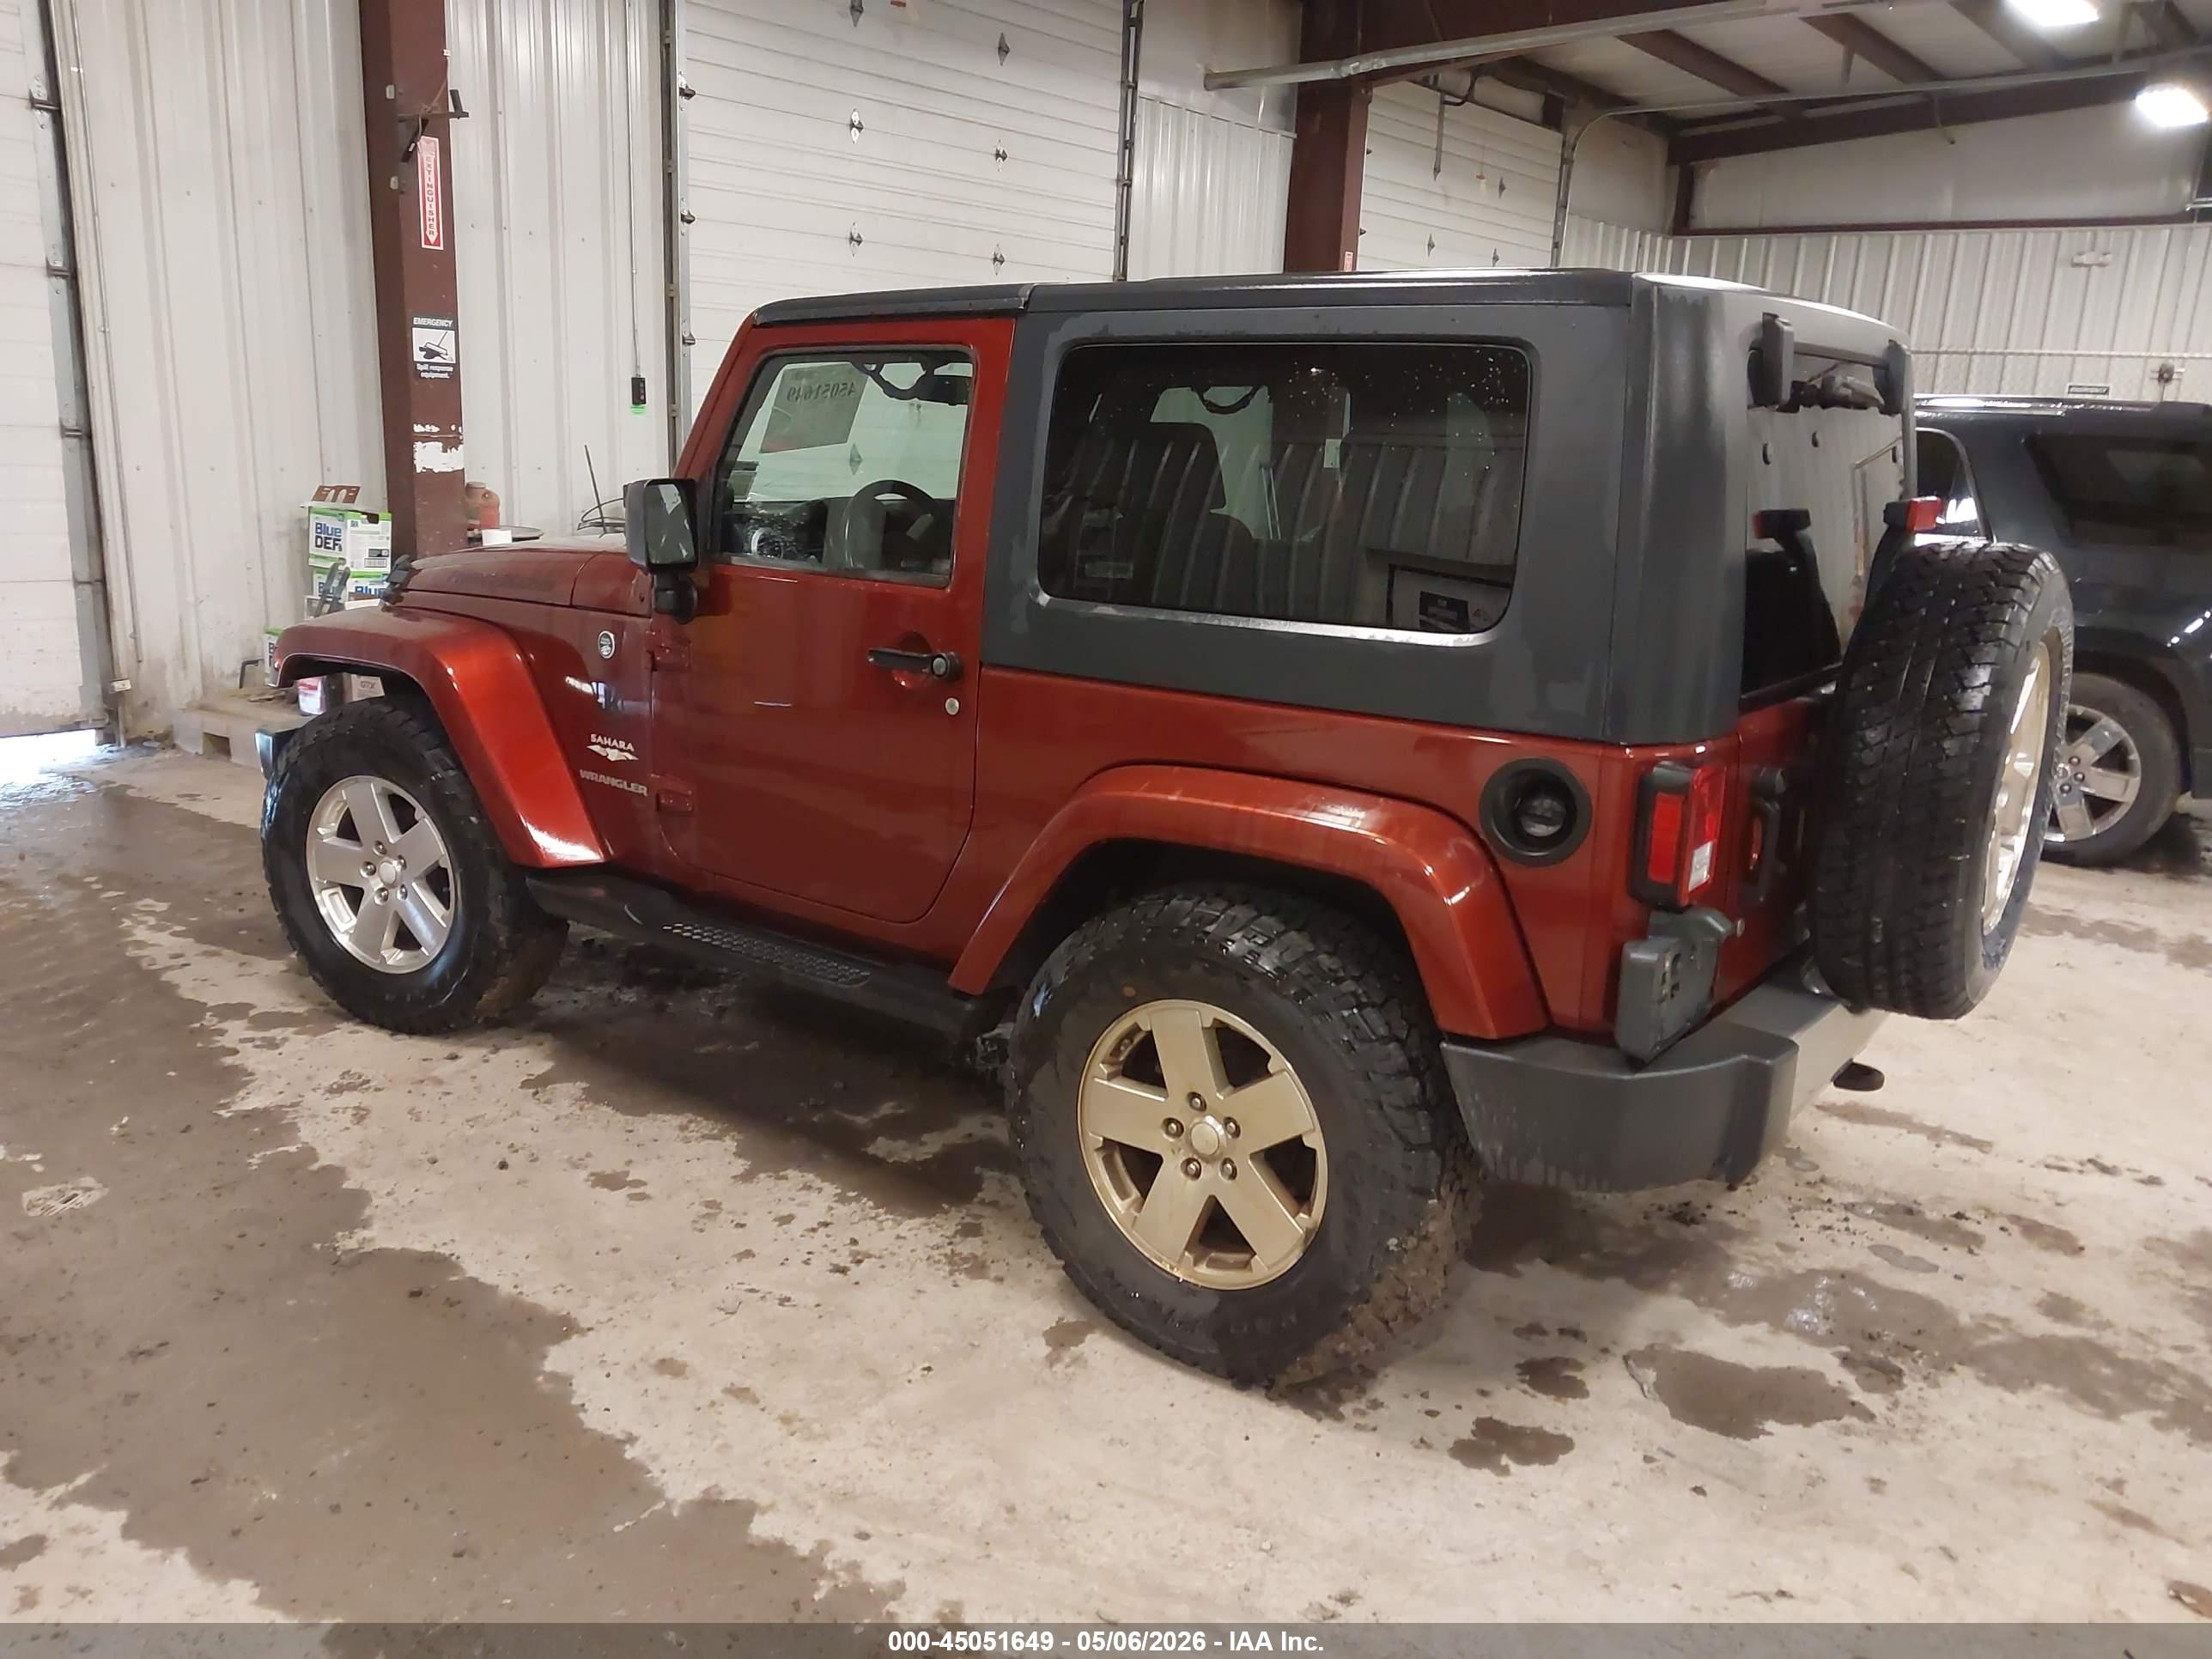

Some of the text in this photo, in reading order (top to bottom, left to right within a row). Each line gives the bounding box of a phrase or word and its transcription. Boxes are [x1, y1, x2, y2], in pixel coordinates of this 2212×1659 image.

[426, 156, 434, 236] EXTINGUISHER
[413, 317, 453, 327] EMERGENCY
[315, 522, 342, 538] Blue
[315, 535, 342, 551] DEF
[590, 733, 635, 751] SAHARA
[580, 769, 648, 796] WRANGLER
